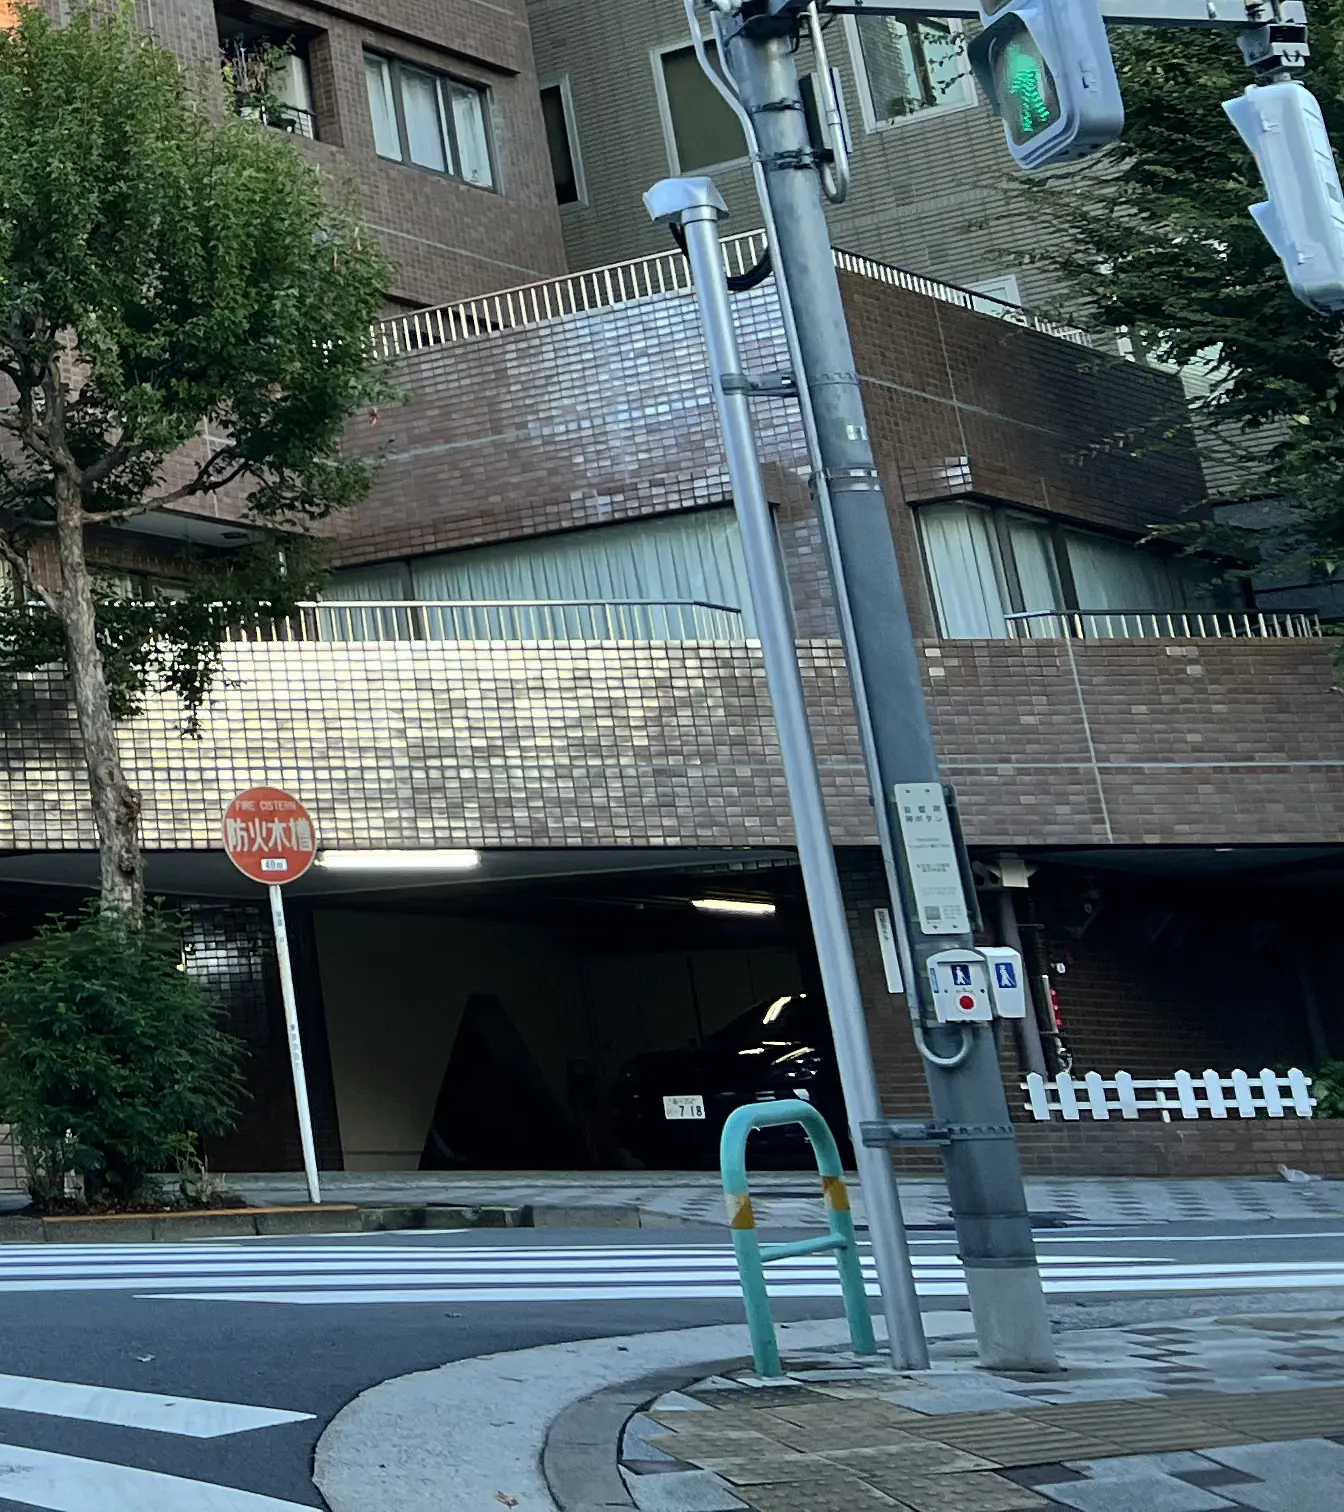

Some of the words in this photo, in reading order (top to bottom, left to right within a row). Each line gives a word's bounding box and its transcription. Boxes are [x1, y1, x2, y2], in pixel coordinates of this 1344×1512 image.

[236, 800, 256, 812] FIRE
[259, 800, 297, 812] CISTERN
[225, 816, 313, 853] 防火水槽
